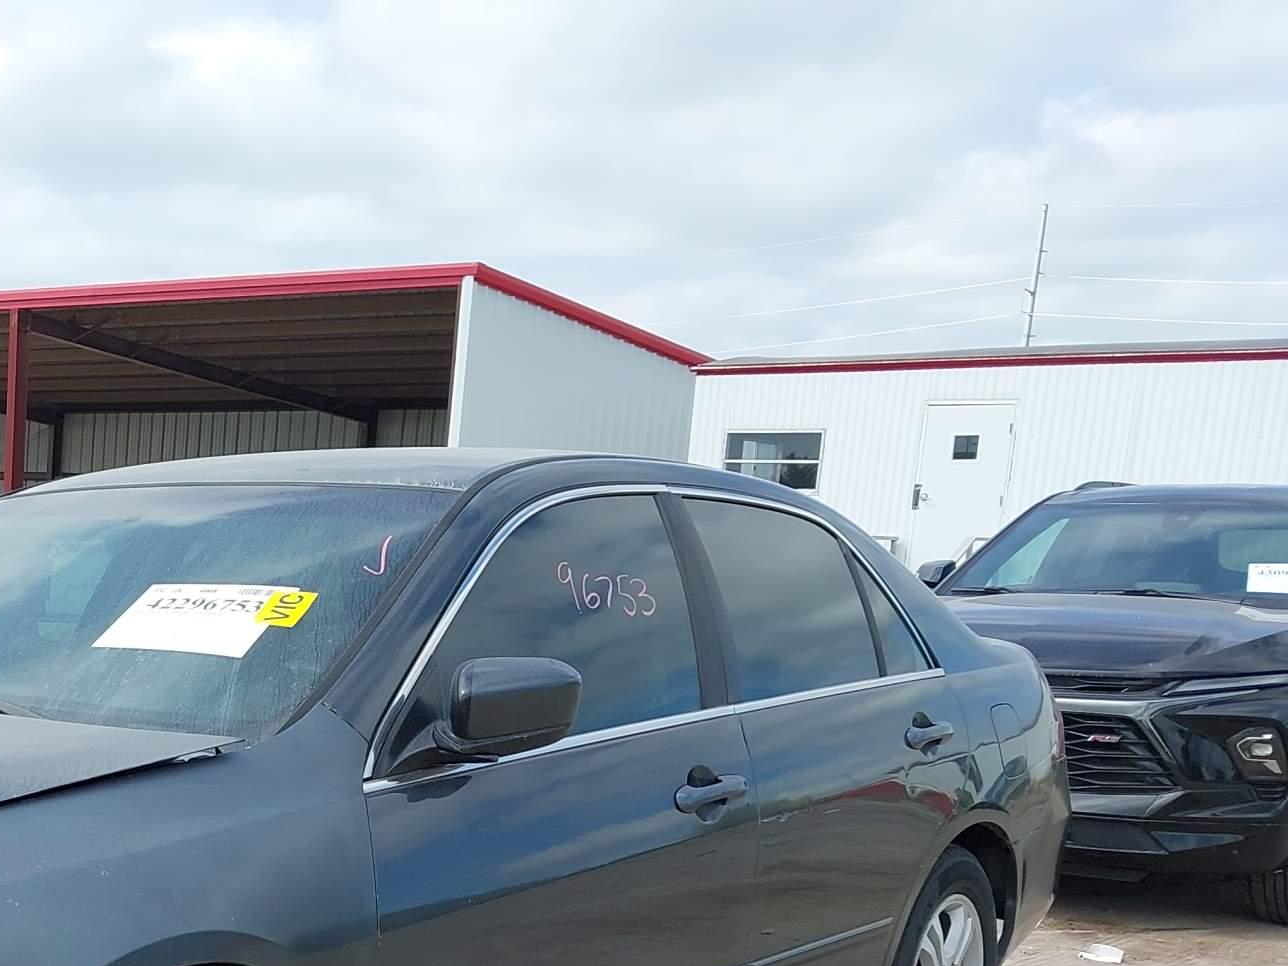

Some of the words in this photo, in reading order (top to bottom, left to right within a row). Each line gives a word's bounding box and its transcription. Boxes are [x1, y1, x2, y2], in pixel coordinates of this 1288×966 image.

[557, 561, 656, 616] 96753
[146, 598, 264, 613] 42296753
[264, 594, 304, 621] VIC
